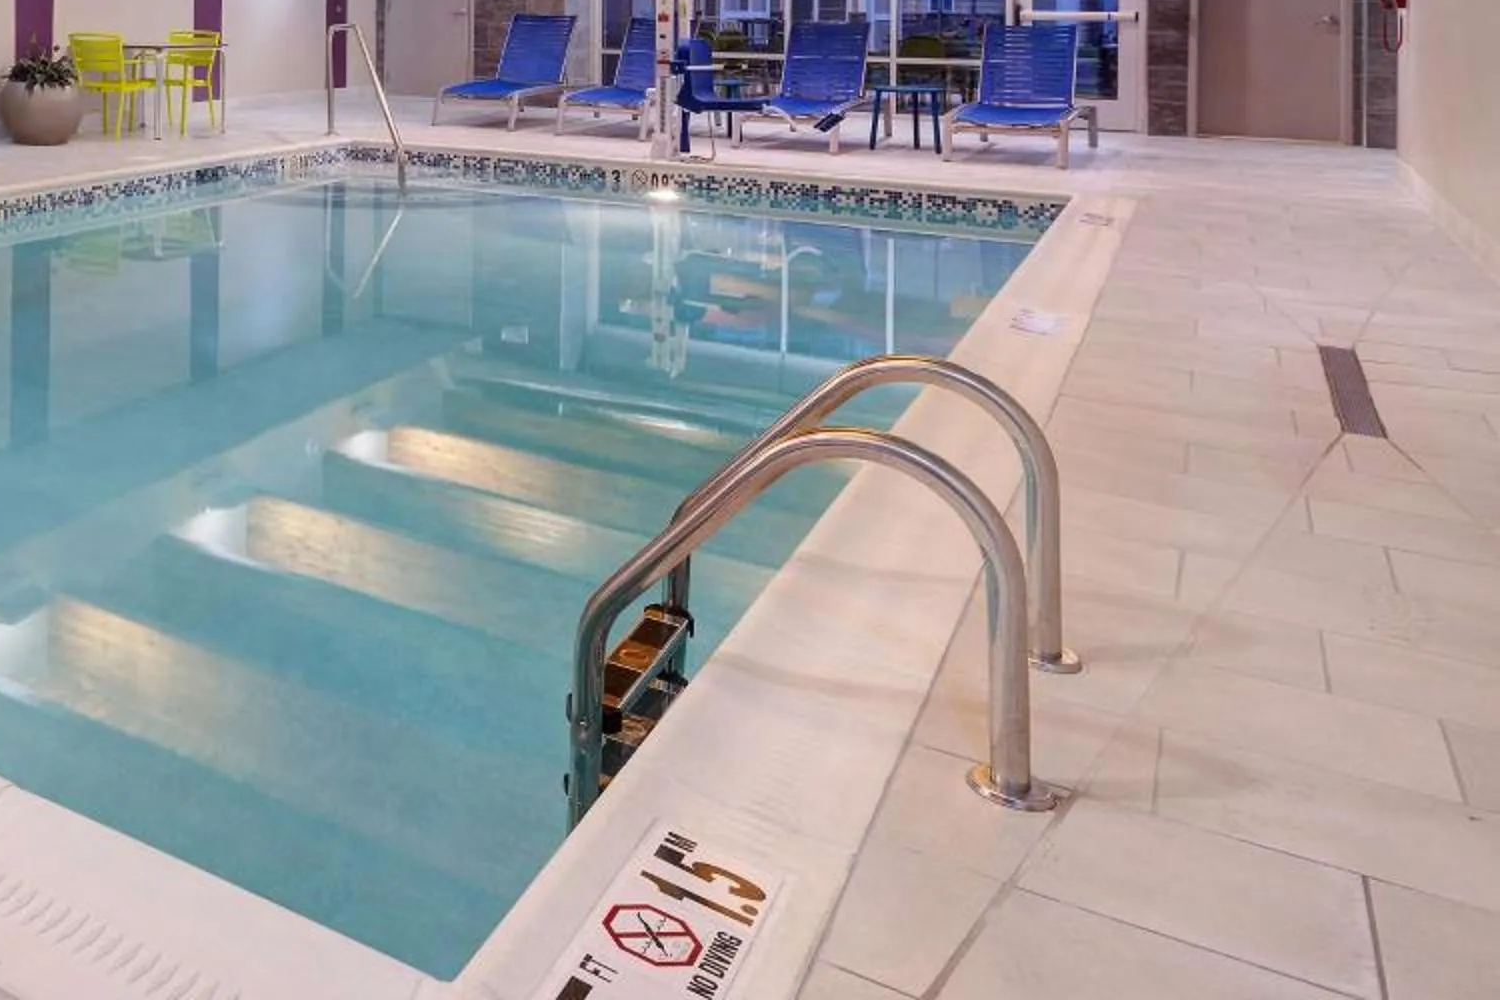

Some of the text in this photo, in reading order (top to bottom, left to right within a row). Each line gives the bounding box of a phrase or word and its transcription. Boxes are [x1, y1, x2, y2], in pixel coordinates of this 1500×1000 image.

[579, 953, 619, 983] FT
[639, 843, 767, 927] 1.5
[686, 930, 743, 1000] NO DIVING
